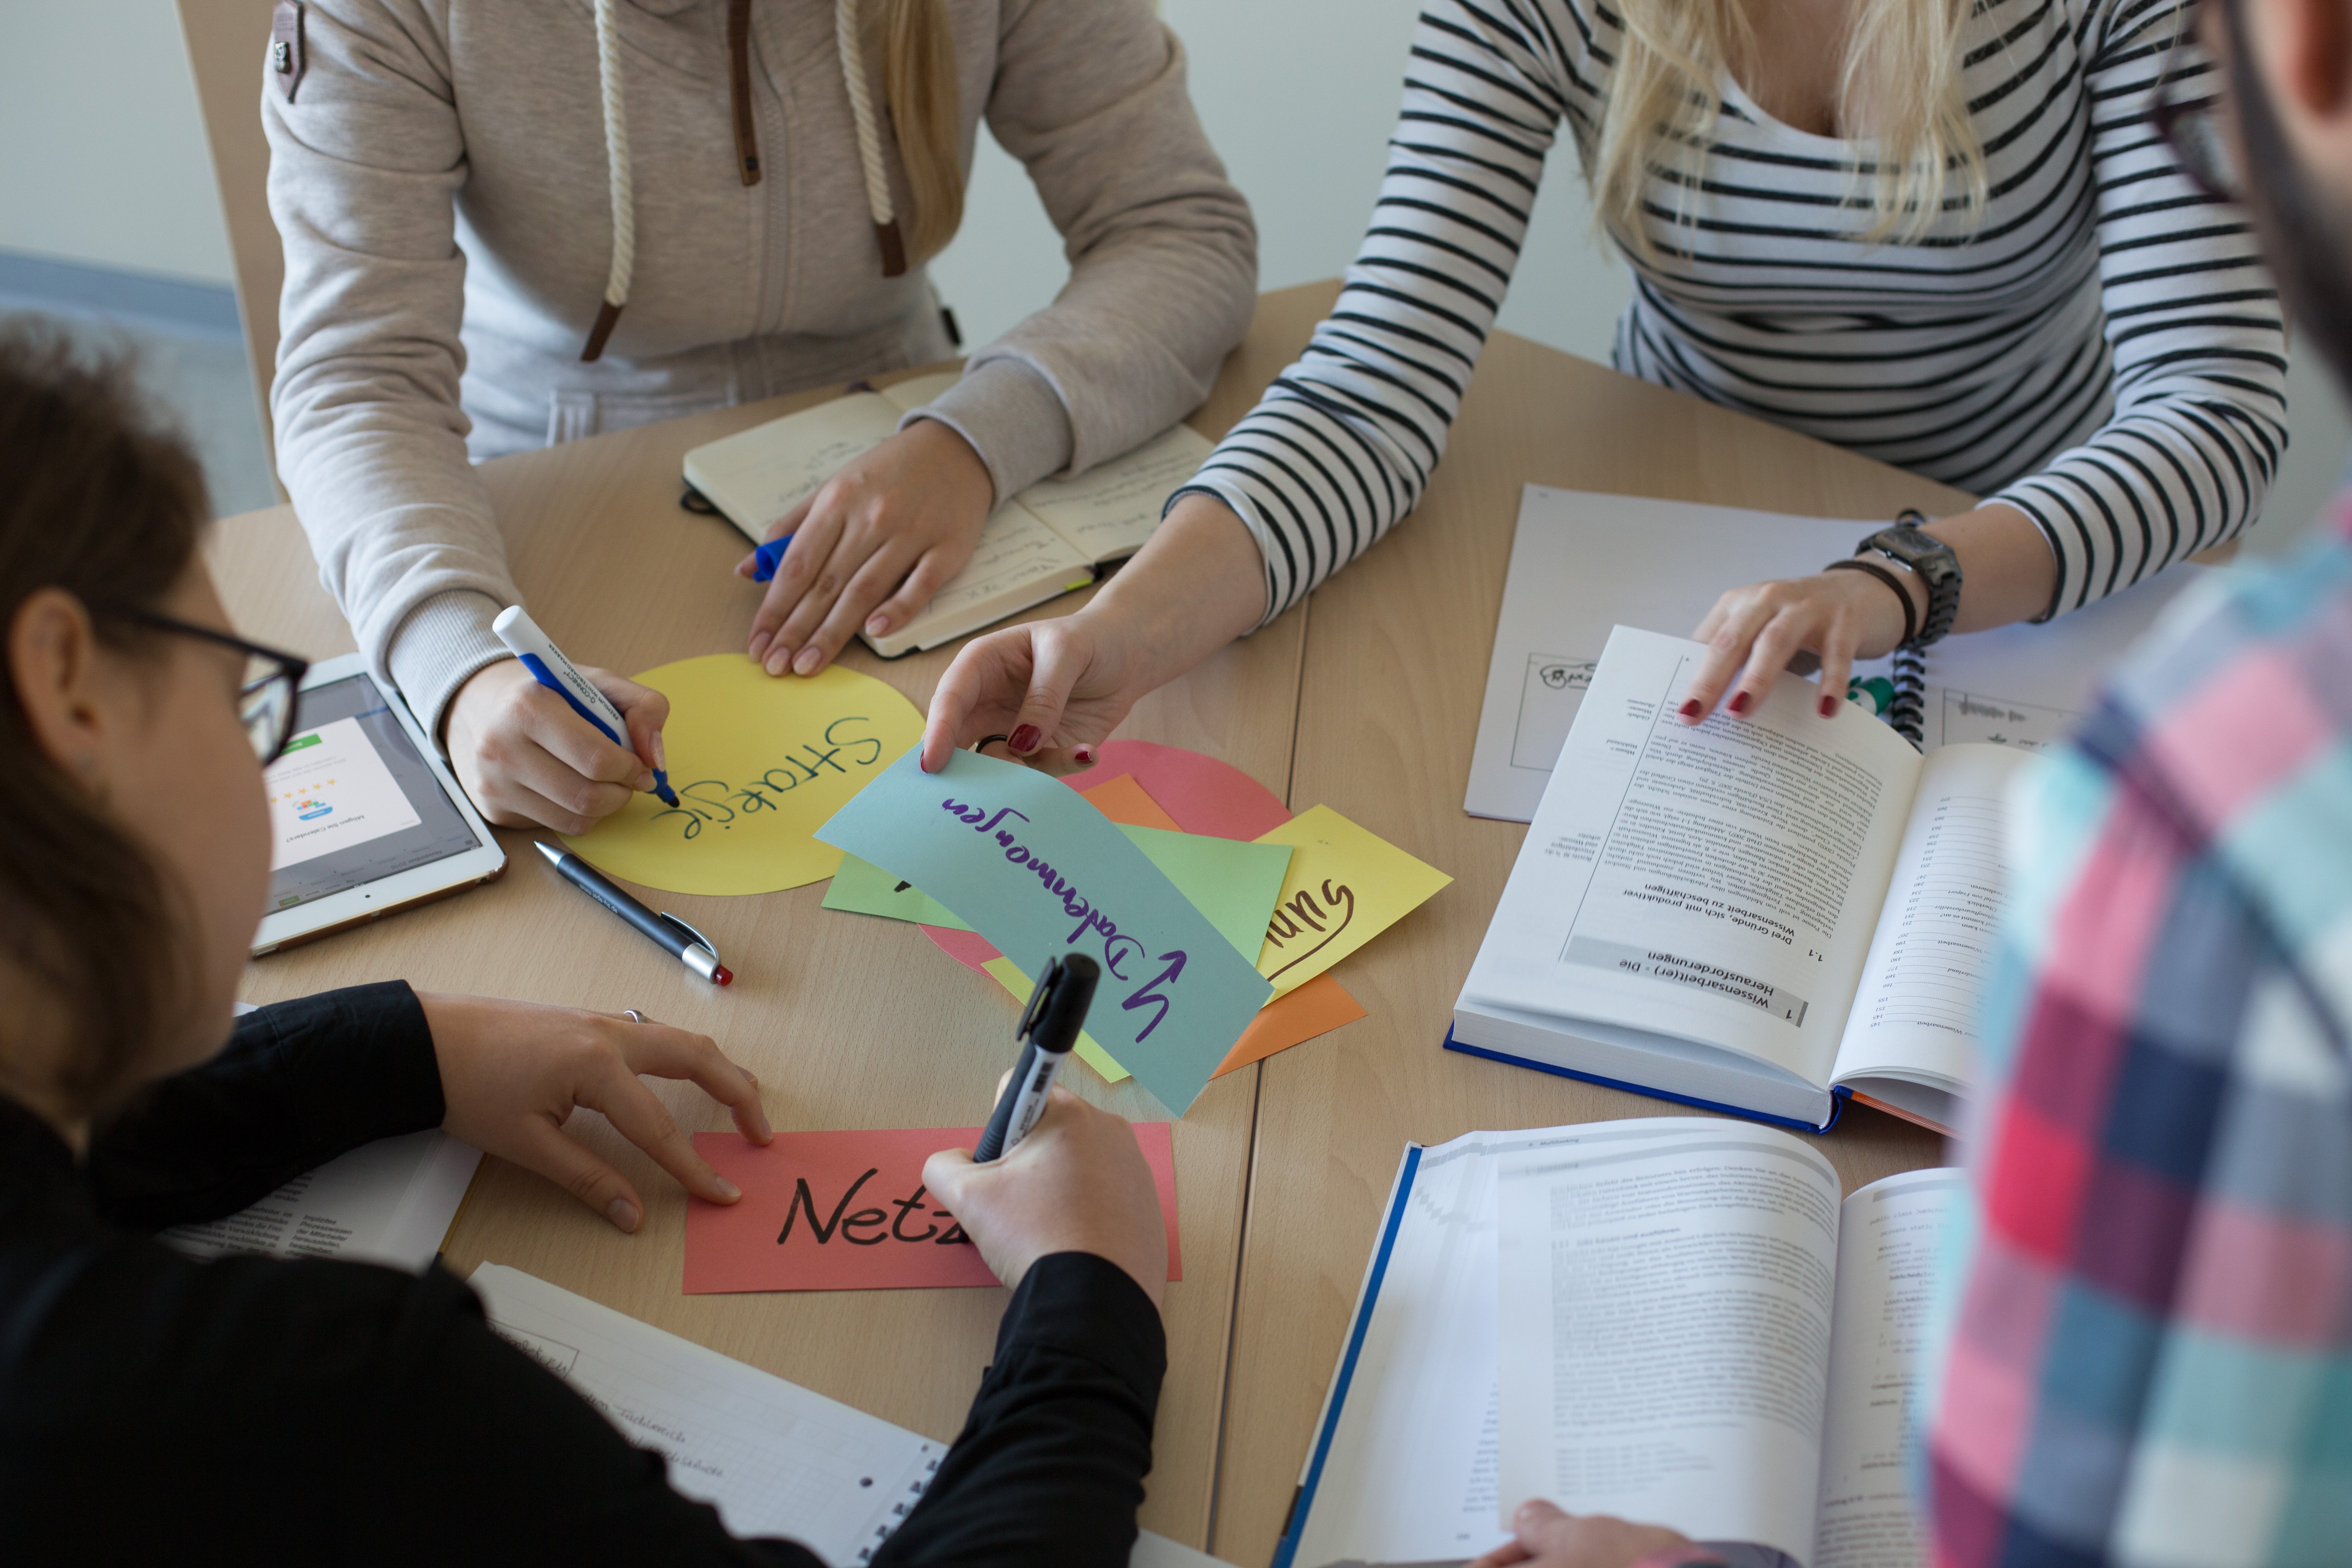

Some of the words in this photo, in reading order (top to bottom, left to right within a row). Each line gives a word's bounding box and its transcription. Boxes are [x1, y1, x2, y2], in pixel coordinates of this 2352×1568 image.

[547, 643, 568, 665] MARKER
[566, 663, 599, 698] WHITEBOARD
[597, 696, 619, 721] PREMIUM
[326, 822, 338, 831] Sie
[338, 813, 365, 827] Mögen
[284, 825, 326, 843] Calendars?
[1790, 822, 1808, 833] deren
[1684, 862, 1700, 870] wird
[1704, 853, 1737, 867] deutschen
[1725, 874, 1746, 884] Dieser
[1766, 873, 1781, 883] über
[1710, 884, 1725, 893] über
[1774, 883, 1793, 895] Anteil
[1781, 879, 1803, 892] Bereits
[1970, 884, 2002, 896] realisieren
[1621, 887, 1683, 908] produktiver
[1643, 881, 1710, 906] beschäftigen
[1726, 888, 1764, 905] Meldungen
[1948, 889, 1970, 897] Fraport
[1683, 902, 1703, 914] mit
[1711, 900, 1725, 908] zu
[1794, 891, 1826, 912] steigenden
[1704, 908, 1726, 921] sich
[1778, 908, 1791, 917] voll
[1816, 910, 1837, 926] schnell
[1726, 904, 1796, 937] Wissensarbeit
[1727, 914, 1769, 935] Gründe,
[1799, 908, 1835, 932] verlagerung
[1800, 918, 1820, 932] Presse
[1961, 915, 1984, 925] kommt
[1771, 931, 1792, 945] Drei
[1937, 940, 1982, 953] Wissensarbeit
[1807, 948, 1824, 962] 1.1
[1617, 958, 1642, 972] Die
[1646, 950, 1774, 996] Herausforderungen
[1652, 964, 1770, 1009] Wissensarbeit(er)
[1785, 1009, 1794, 1020] 1
[1916, 1019, 1963, 1035] Wissensarbeit
